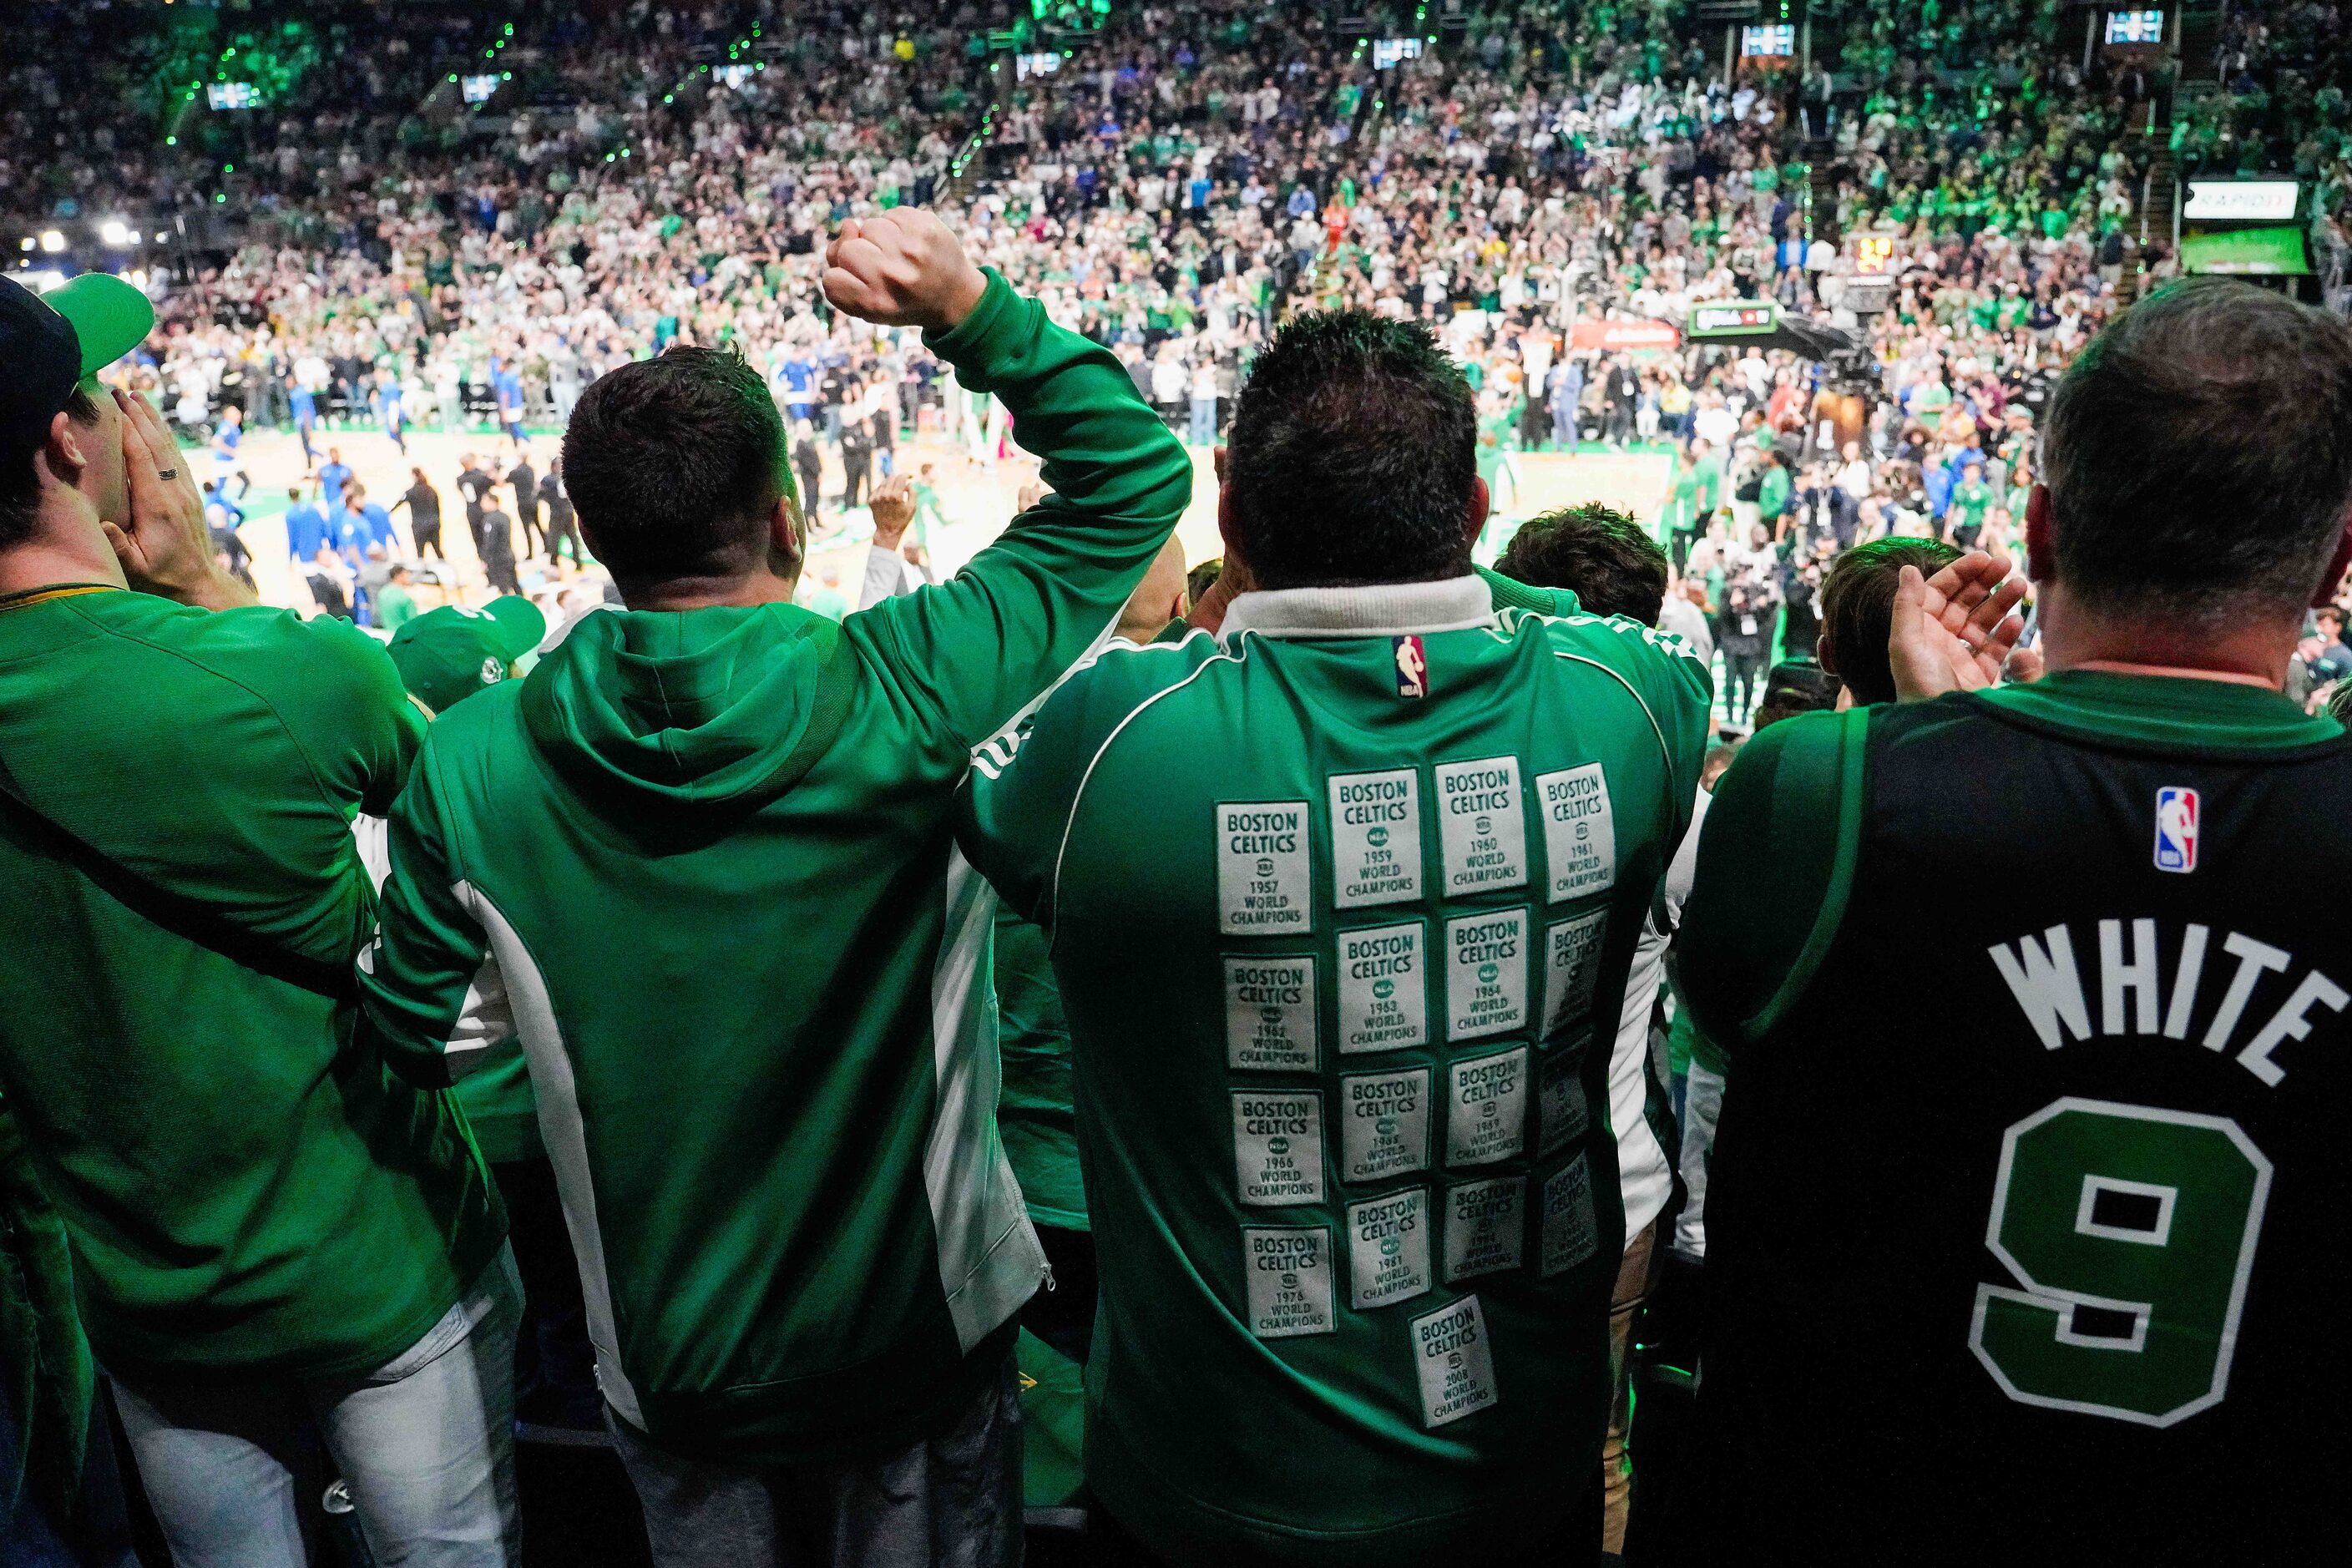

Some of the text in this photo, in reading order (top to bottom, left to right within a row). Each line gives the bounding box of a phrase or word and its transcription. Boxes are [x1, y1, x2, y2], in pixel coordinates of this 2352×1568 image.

[1446, 770, 1509, 793] BOSTON
[1548, 776, 1599, 802] BOSTON
[1340, 781, 1407, 803] BOSTON
[1451, 792, 1510, 814] CELTICS
[1554, 796, 1601, 822] CELTICS
[1227, 813, 1297, 832] BOSTON
[1344, 802, 1407, 825] CELTICS
[1231, 834, 1296, 854] CELTICS
[1471, 838, 1497, 852] 1960
[1571, 843, 1592, 857] 1961
[1364, 850, 1392, 863] 1959
[1466, 852, 1505, 867] WORLD
[1568, 857, 1600, 873] WORLD
[1360, 865, 1401, 879] WORLD
[1454, 867, 1516, 886] CHAMPIONS
[1557, 868, 1608, 892] CHAMPIONS
[1250, 881, 1278, 893] 1957
[1346, 878, 1413, 897] CHAMPIONS
[1245, 896, 1287, 908] WORLD
[1231, 910, 1302, 925] CHAMPIONS
[1456, 921, 1519, 945] BOSTON
[1348, 935, 1414, 959] BOSTON
[1459, 940, 1515, 964] CELTICS
[1235, 969, 1302, 984] BOSTON
[1352, 955, 1411, 979] CELTICS
[1238, 988, 1301, 1003] CELTICS
[1475, 985, 1500, 999] 1964
[1370, 1001, 1397, 1014] 1963
[1469, 999, 1508, 1013] WORLD
[1987, 918, 2351, 1087] WHITE
[1364, 1014, 1404, 1029] WORLD
[1458, 1009, 1518, 1030] CHAMPIONS
[1257, 1025, 1285, 1038] 1962
[1350, 1026, 1416, 1044] CHAMPIONS
[1252, 1038, 1293, 1050] WORLD
[1239, 1051, 1308, 1064] CHAMPIONS
[1459, 1059, 1518, 1086] BOSTON
[1353, 1080, 1417, 1100] BOSTON
[1462, 1076, 1514, 1104] CELTICS
[1243, 1102, 1308, 1117] BOSTON
[1356, 1097, 1415, 1117] CELTICS
[1247, 1120, 1307, 1135] CELTICS
[1469, 1130, 1505, 1146] WORLD
[1367, 1145, 1405, 1161] WORLD
[1456, 1140, 1515, 1160] CHAMPIONS
[1265, 1157, 1293, 1169] 1966
[1354, 1155, 1415, 1175] CHAMPIONS
[1261, 1171, 1301, 1182] WORLD
[1248, 1183, 1313, 1196] CHAMPIONS
[1457, 1185, 1516, 1205] BOSTON
[1358, 1197, 1417, 1226] BOSTON
[1458, 1199, 1512, 1219] CELTICS
[1361, 1215, 1416, 1242] CELTICS
[1254, 1237, 1318, 1252] BOSTON
[1257, 1253, 1317, 1271] CELTICS
[1378, 1257, 1402, 1270] 1981
[1968, 1096, 2274, 1429] 9
[1375, 1266, 1410, 1285] WORLD
[1363, 1275, 1420, 1300] CHAMPIONS
[1272, 1303, 1311, 1315] WORLD
[1259, 1315, 1323, 1329] CHAMPIONS
[1421, 1306, 1474, 1342] BOSTON
[1425, 1325, 1477, 1358] CELTICS
[1446, 1369, 1468, 1387] 2008
[1443, 1380, 1477, 1401] WORLD
[1434, 1388, 1489, 1418] CHAMPIONS
